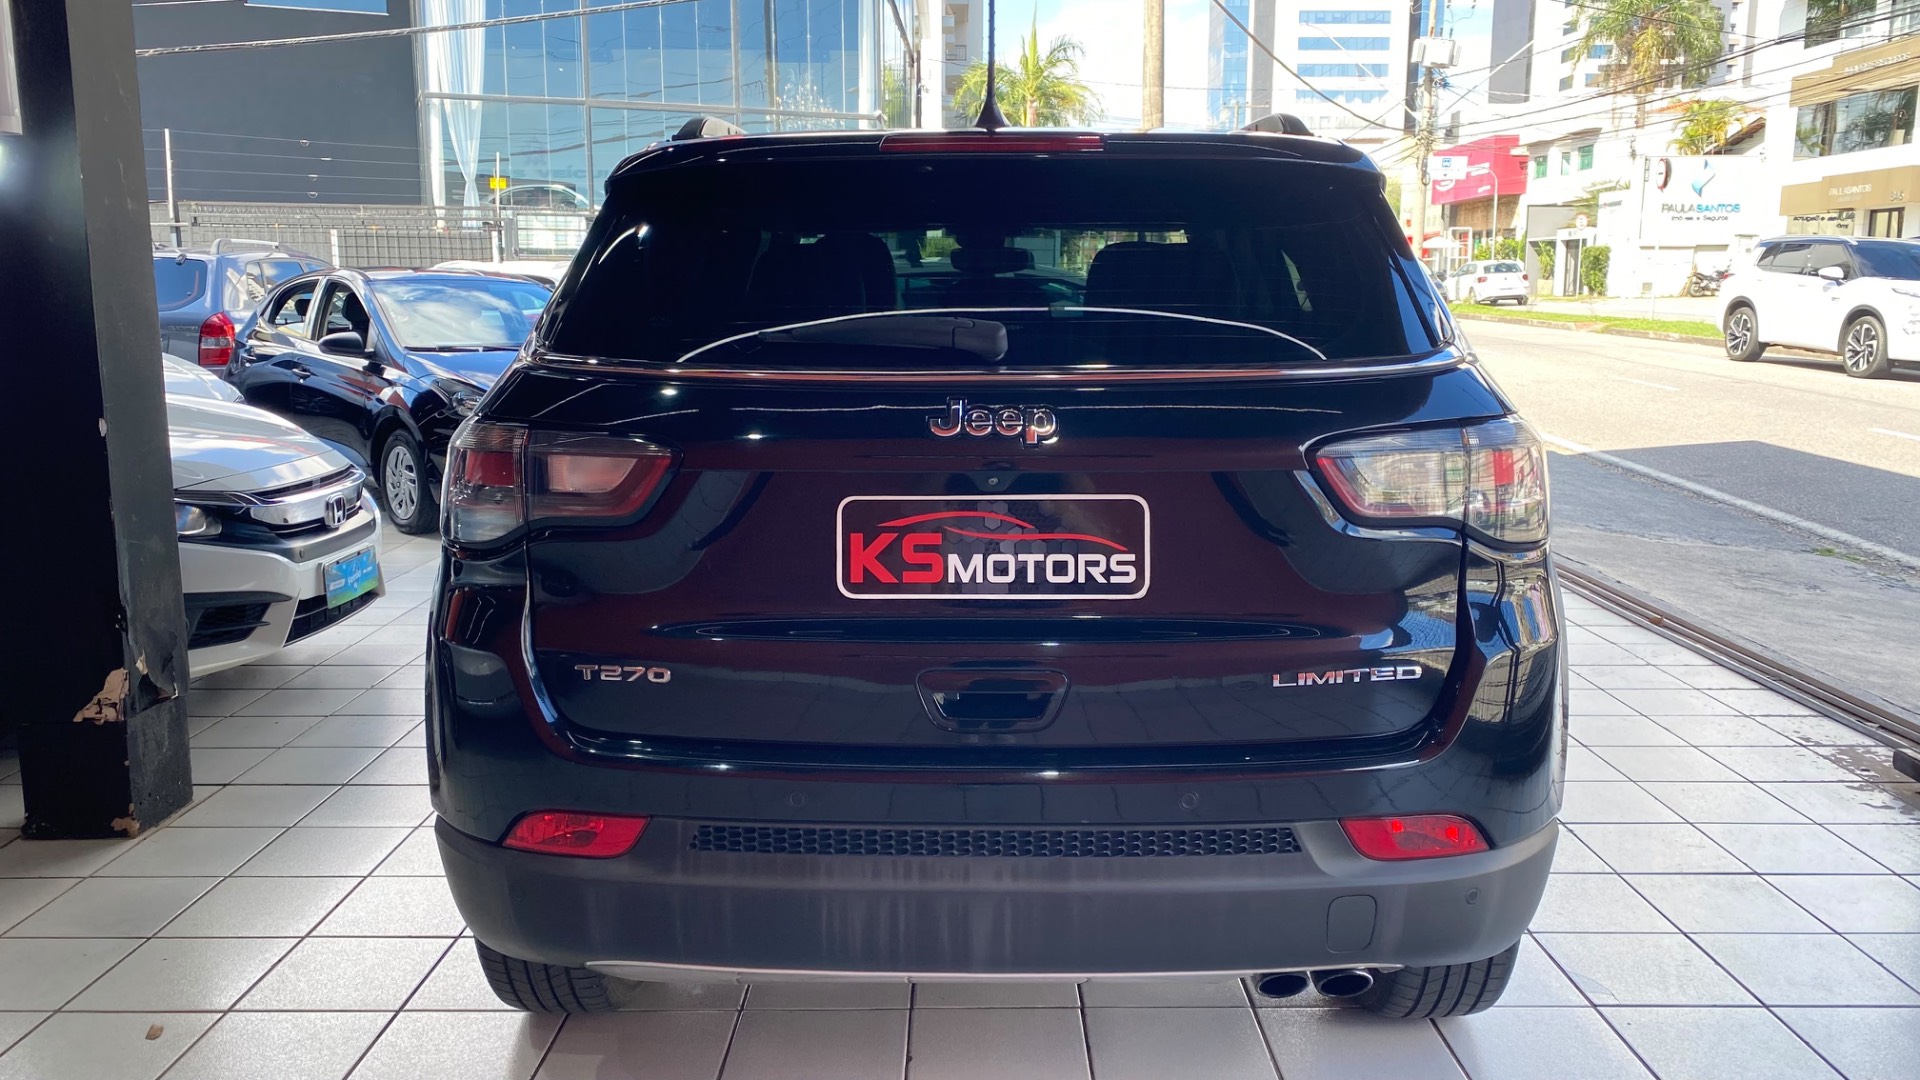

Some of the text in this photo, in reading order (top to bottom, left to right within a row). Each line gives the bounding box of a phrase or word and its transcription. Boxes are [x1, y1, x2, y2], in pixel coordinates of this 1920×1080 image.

[926, 397, 1058, 448] Jeep
[947, 553, 1137, 584] MOTORS
[574, 664, 671, 684] T270
[1272, 665, 1423, 688] LIMITED
